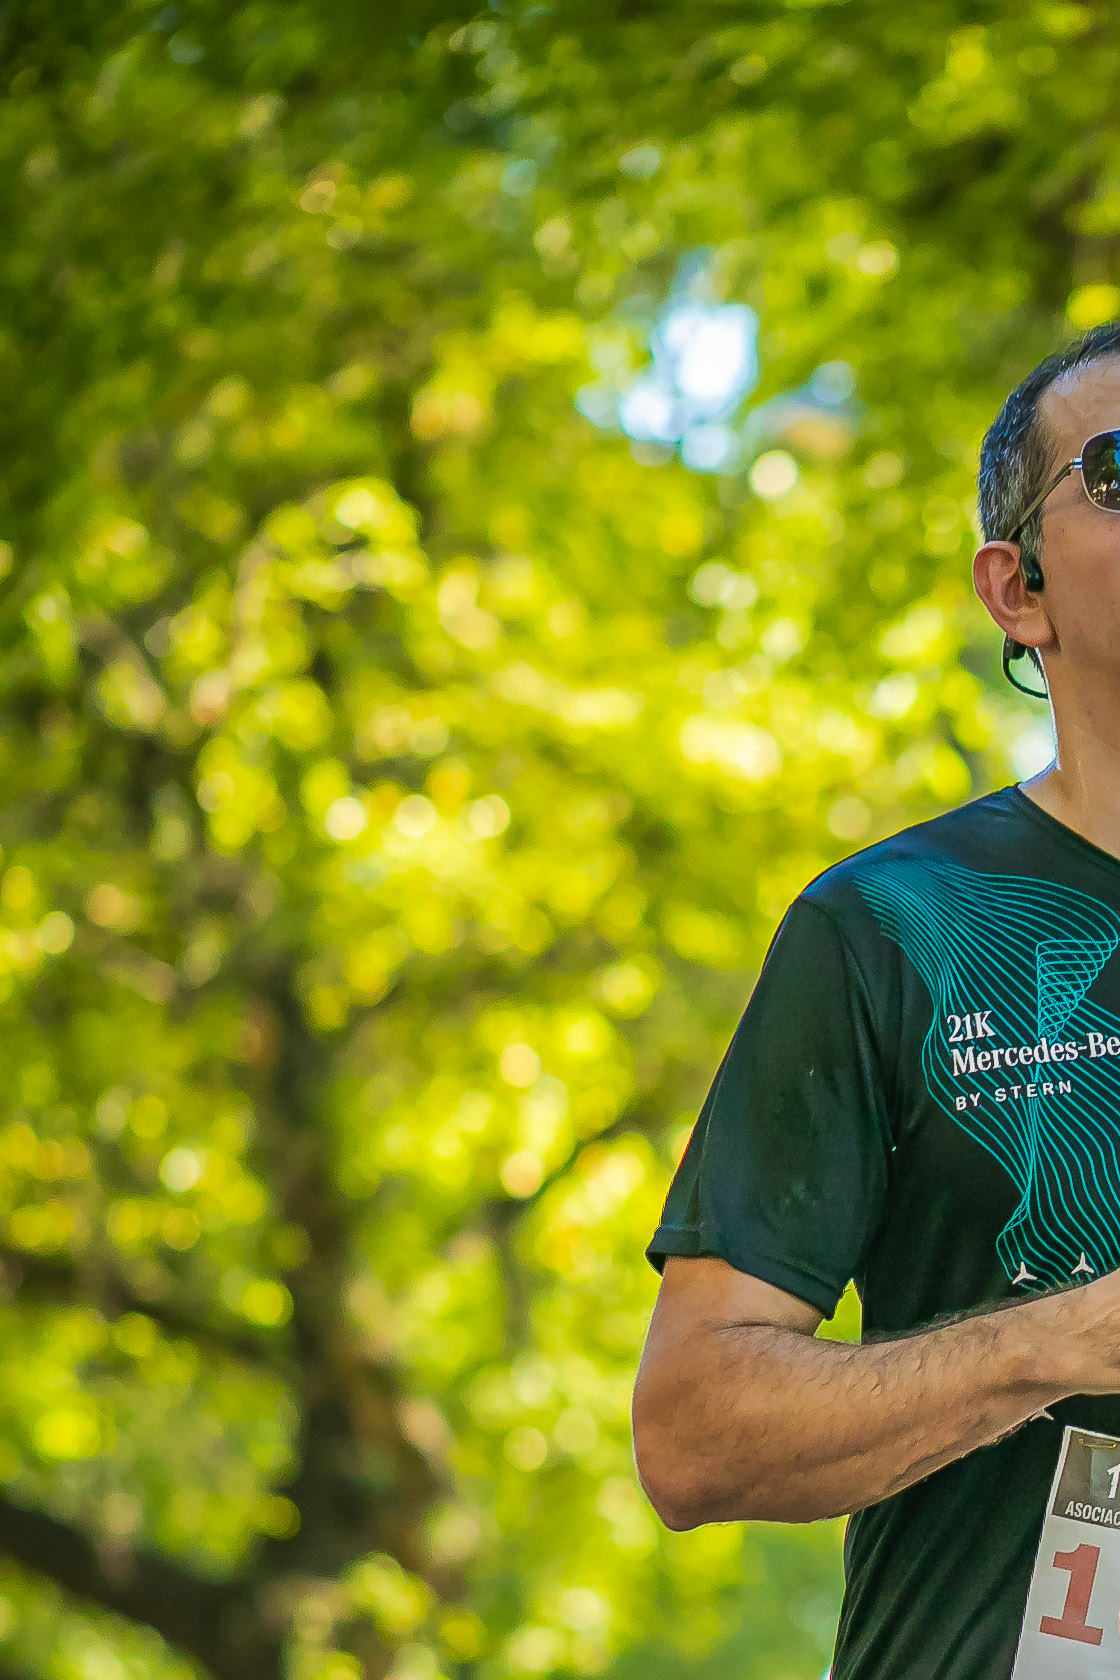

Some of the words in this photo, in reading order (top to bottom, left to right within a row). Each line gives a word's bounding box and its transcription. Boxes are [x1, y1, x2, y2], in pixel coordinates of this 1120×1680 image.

[947, 1010, 996, 1042] 21K
[955, 1092, 981, 1111] BY
[995, 1080, 1072, 1102] STERN
